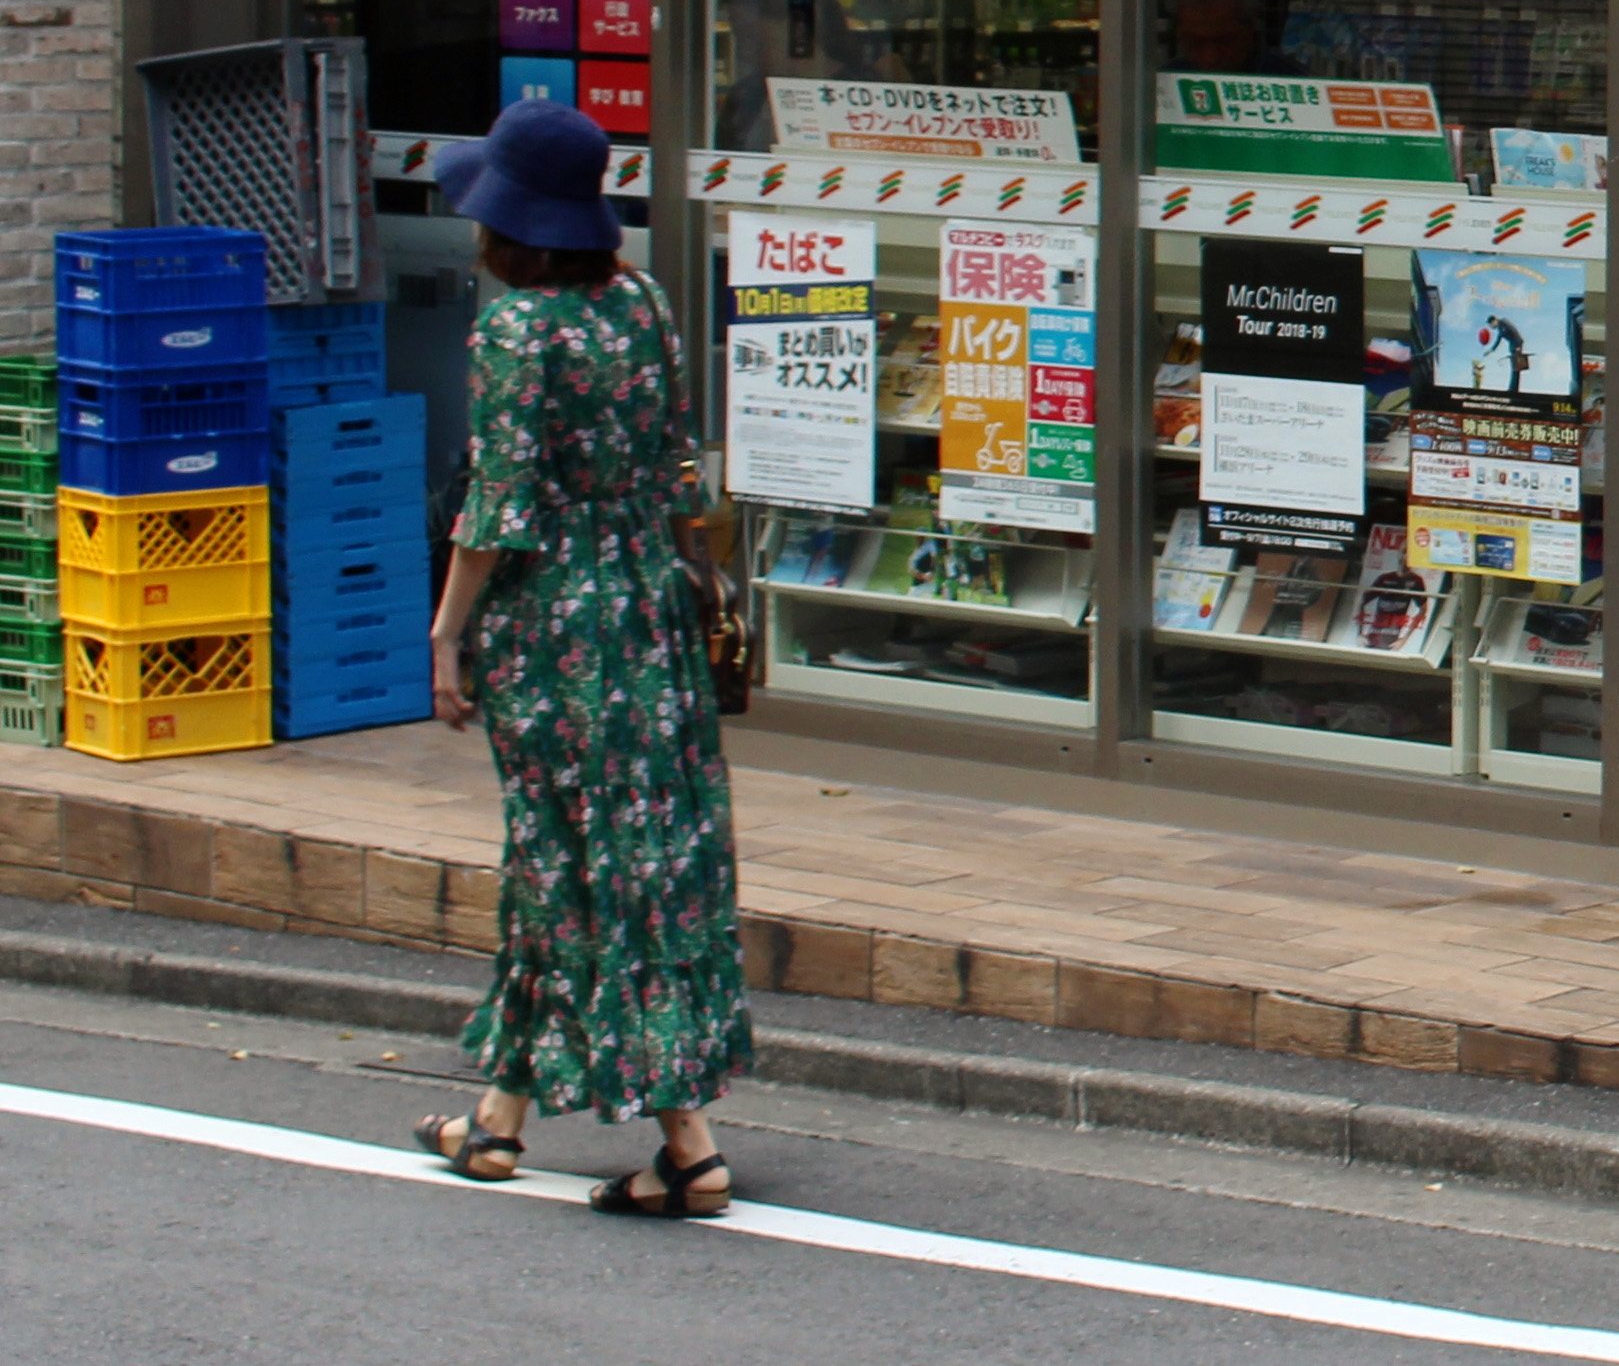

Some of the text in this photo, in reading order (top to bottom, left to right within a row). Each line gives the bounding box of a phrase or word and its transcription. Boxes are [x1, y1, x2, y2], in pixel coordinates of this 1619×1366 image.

[512, 5, 560, 24] ファクス
[592, 20, 640, 37] サービス
[817, 86, 1058, 118] 本・CD・DVDをネットで注文!
[1220, 80, 1321, 105] 雑誌お取置き
[1225, 105, 1295, 124] サービス
[1527, 165, 1556, 178] HOUSE
[757, 228, 845, 275] たばこ
[944, 247, 1048, 303] 保険
[1226, 283, 1338, 315] Mr.Children
[948, 315, 1022, 362] バイク
[1236, 313, 1327, 340] Tour 2018-19
[777, 326, 868, 358] まとめ買いが
[776, 361, 868, 393] オススメ!
[1462, 417, 1580, 446] 映画前売券販売中!
